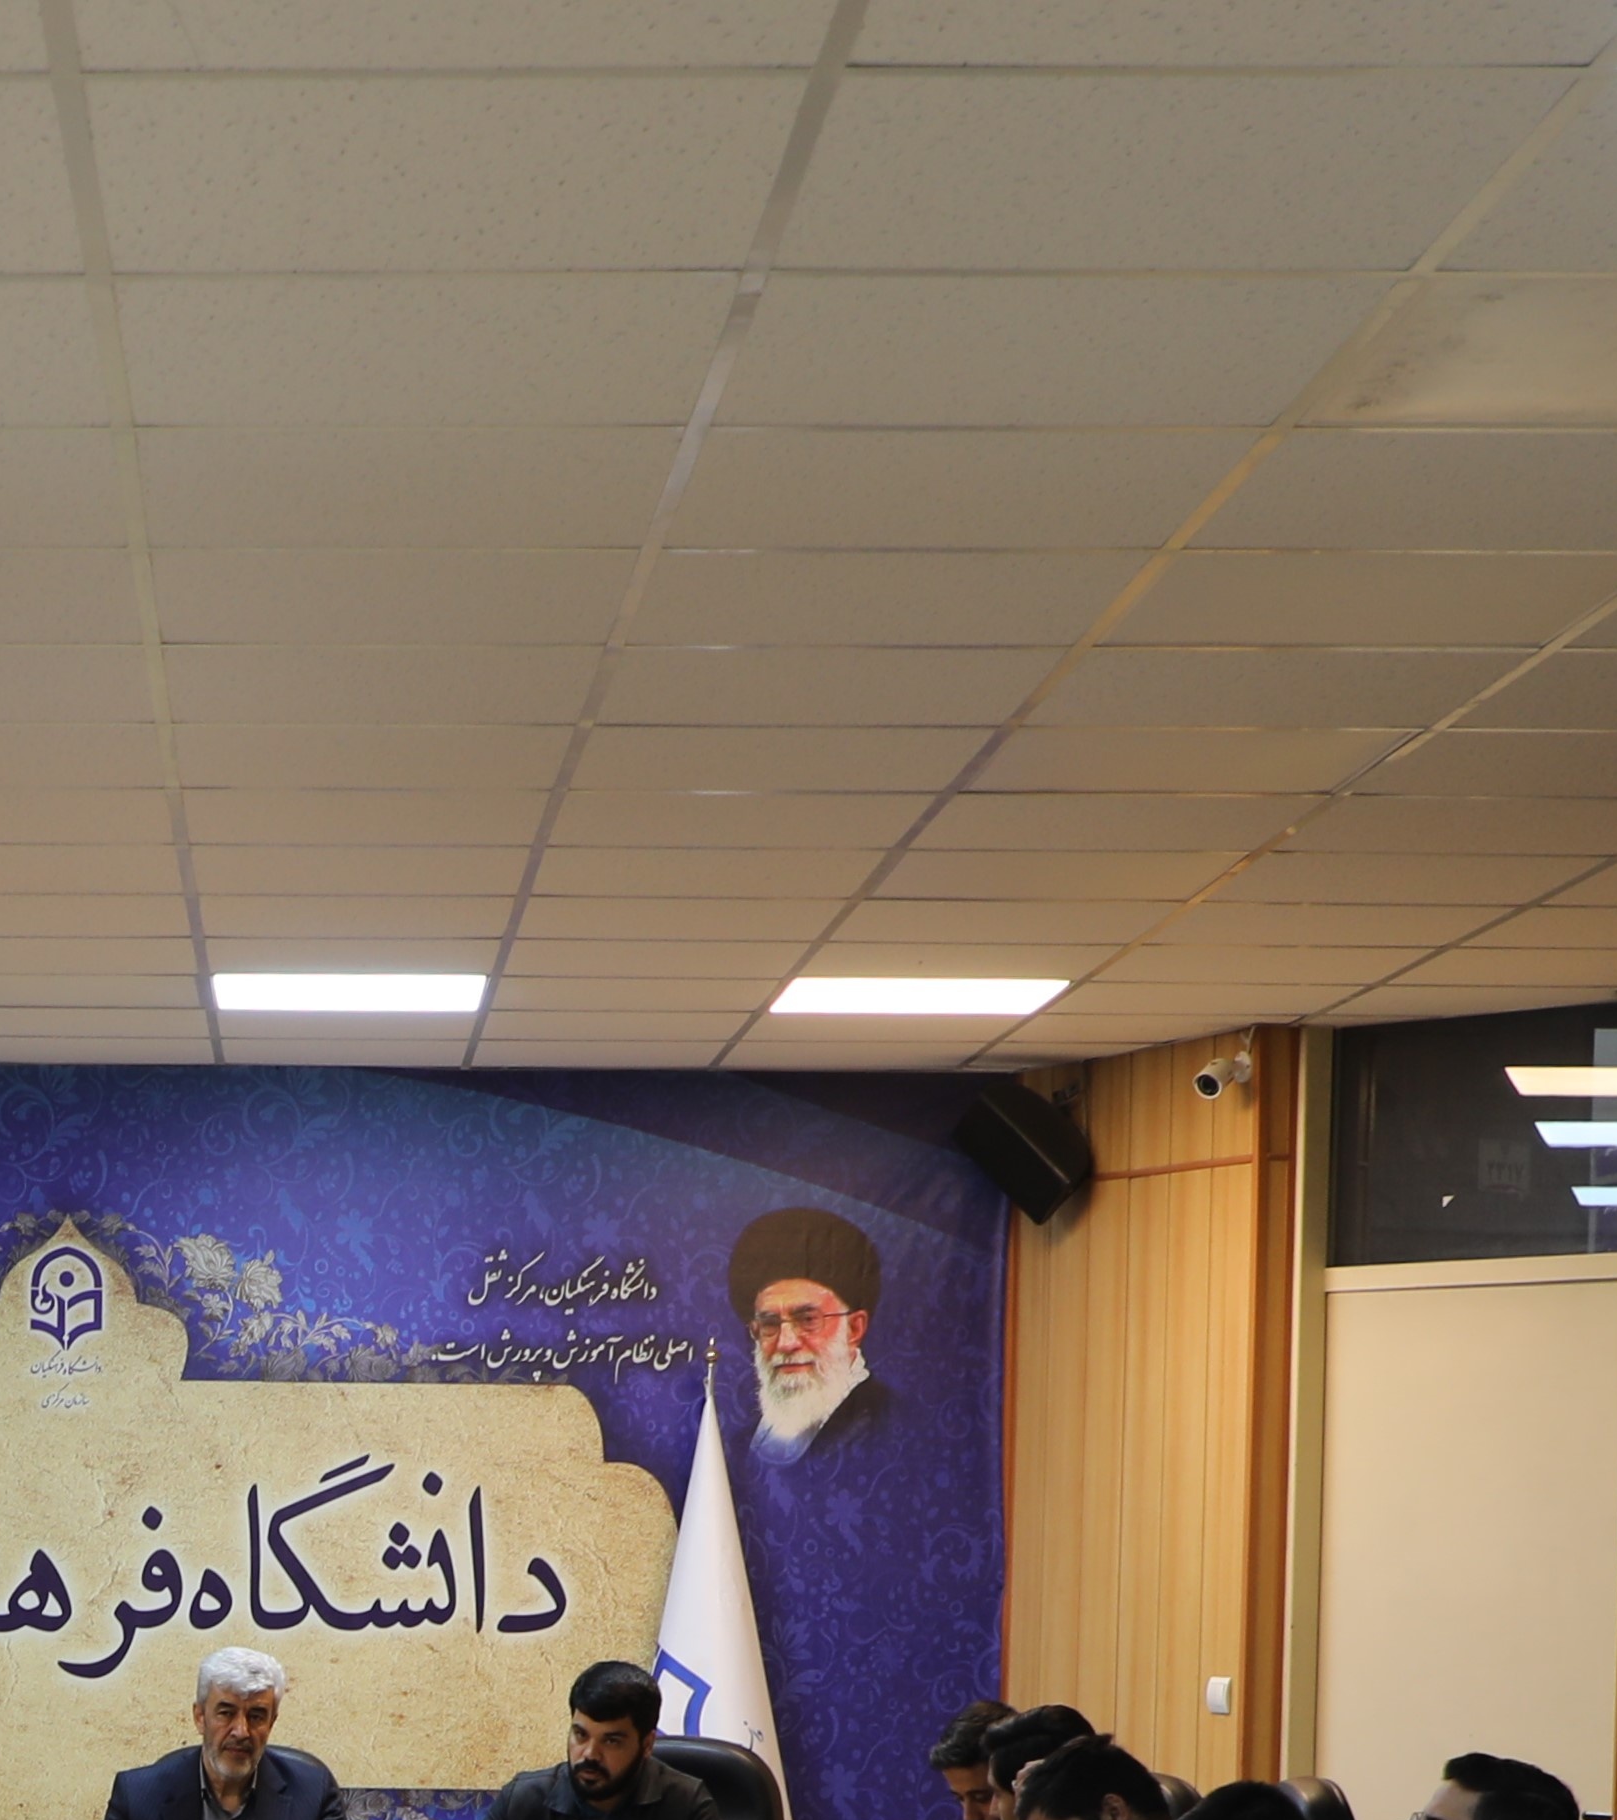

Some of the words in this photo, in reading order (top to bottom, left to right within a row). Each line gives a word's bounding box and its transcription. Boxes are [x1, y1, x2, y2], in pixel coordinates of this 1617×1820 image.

[467, 1249, 508, 1306] ثقل
[504, 1251, 545, 1306] مرکز
[609, 1257, 658, 1301] دانشگاه
[485, 1328, 545, 1382] پرورش
[551, 1328, 624, 1370] آموزش
[614, 1335, 655, 1385] نظام
[653, 1338, 695, 1371] اصلی
[187, 1453, 568, 1635] دانشگاه
